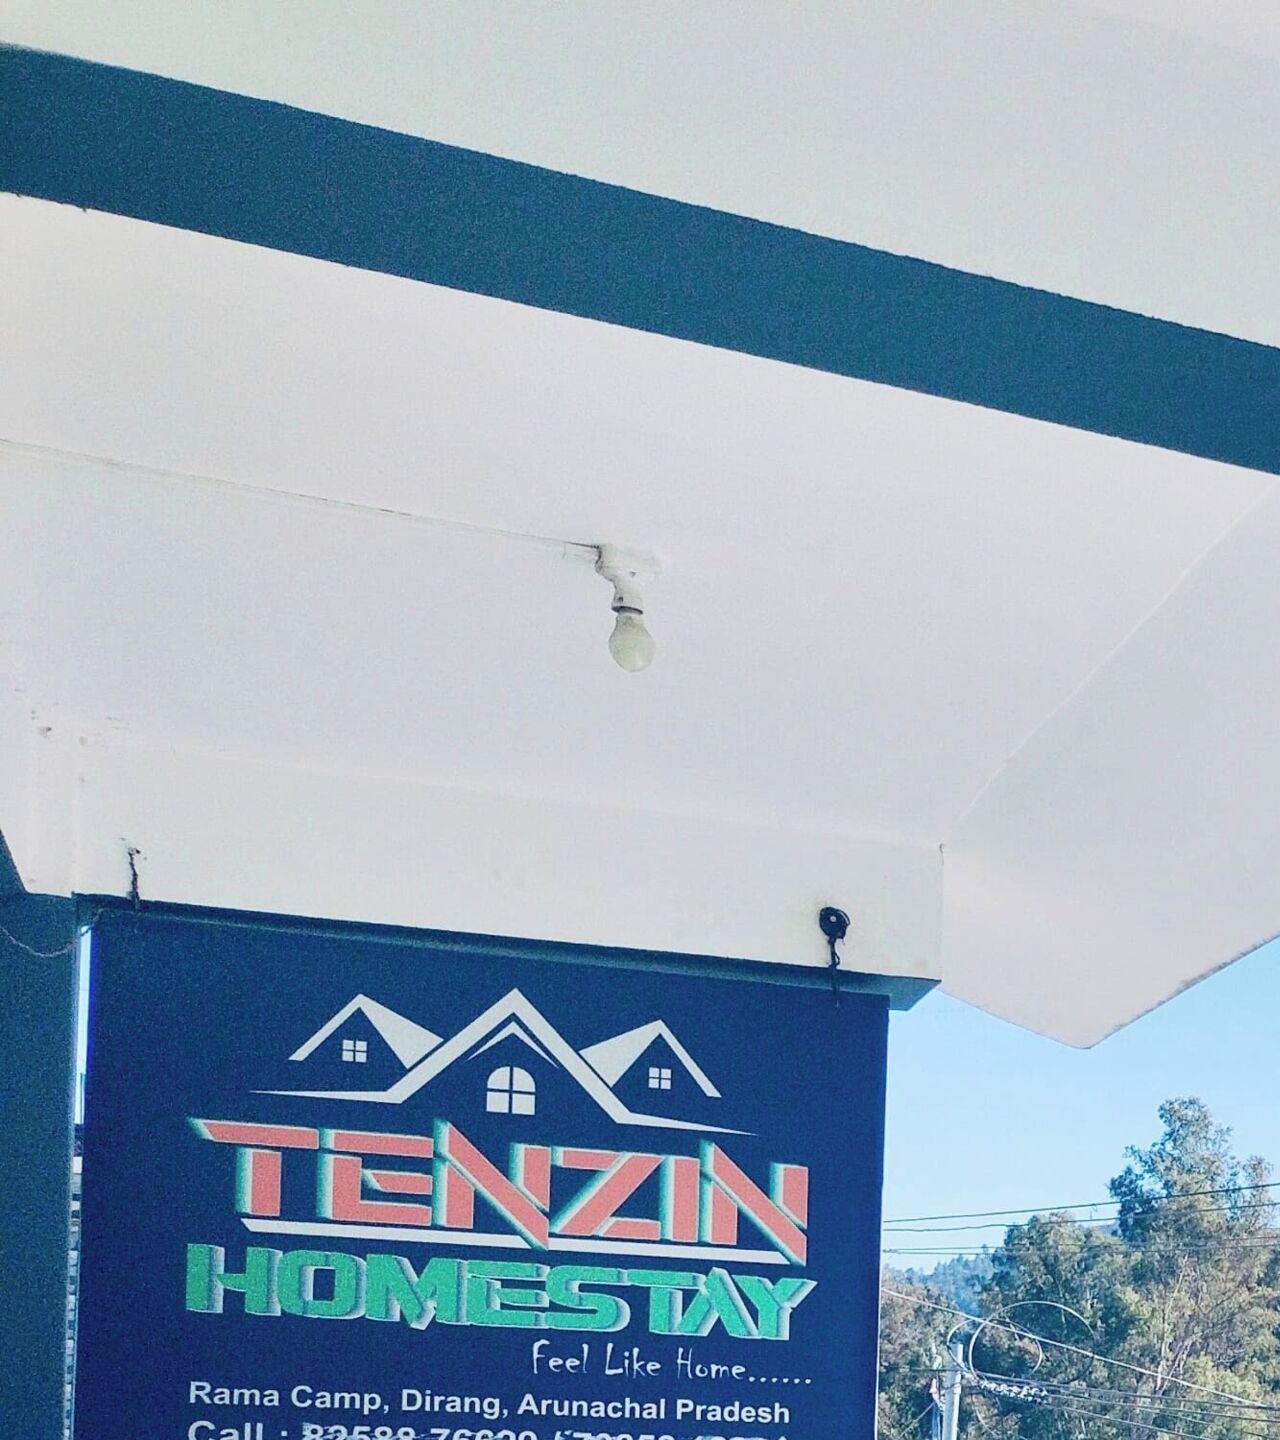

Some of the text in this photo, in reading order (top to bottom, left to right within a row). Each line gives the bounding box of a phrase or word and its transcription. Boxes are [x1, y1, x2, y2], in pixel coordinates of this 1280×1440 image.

[186, 1118, 808, 1266] TENZIN
[185, 1243, 817, 1340] HOMESTAY
[532, 1339, 589, 1375] Feel
[605, 1343, 662, 1379] Like
[189, 1381, 790, 1424] Rama Camp, Dirang, Arunachal Pradesh
